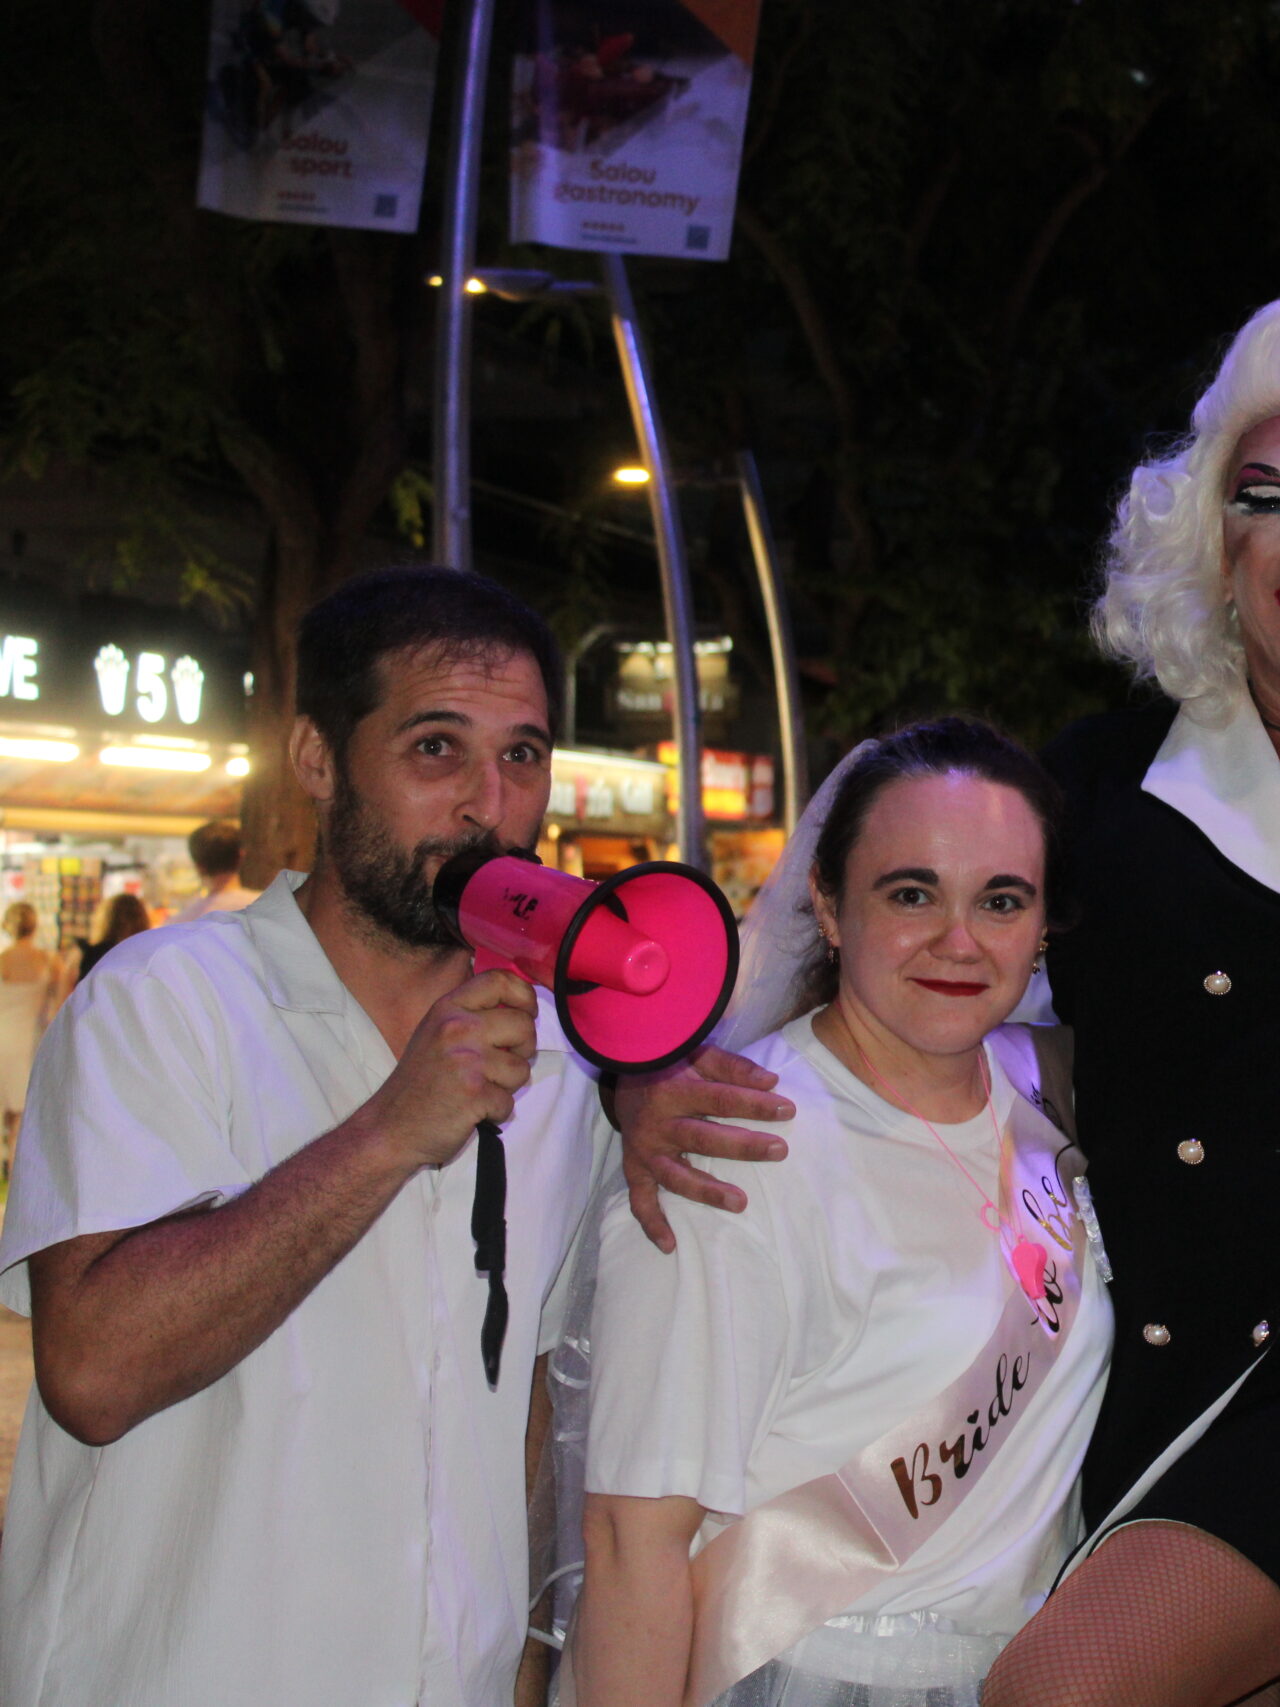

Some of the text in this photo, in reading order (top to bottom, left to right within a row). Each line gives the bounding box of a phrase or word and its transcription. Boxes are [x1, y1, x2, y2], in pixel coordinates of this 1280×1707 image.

[280, 128, 349, 155] Salou
[290, 156, 353, 179] sport
[591, 160, 657, 186] Salou
[555, 182, 699, 216] gastronomy
[891, 1352, 1031, 1520] Bride
